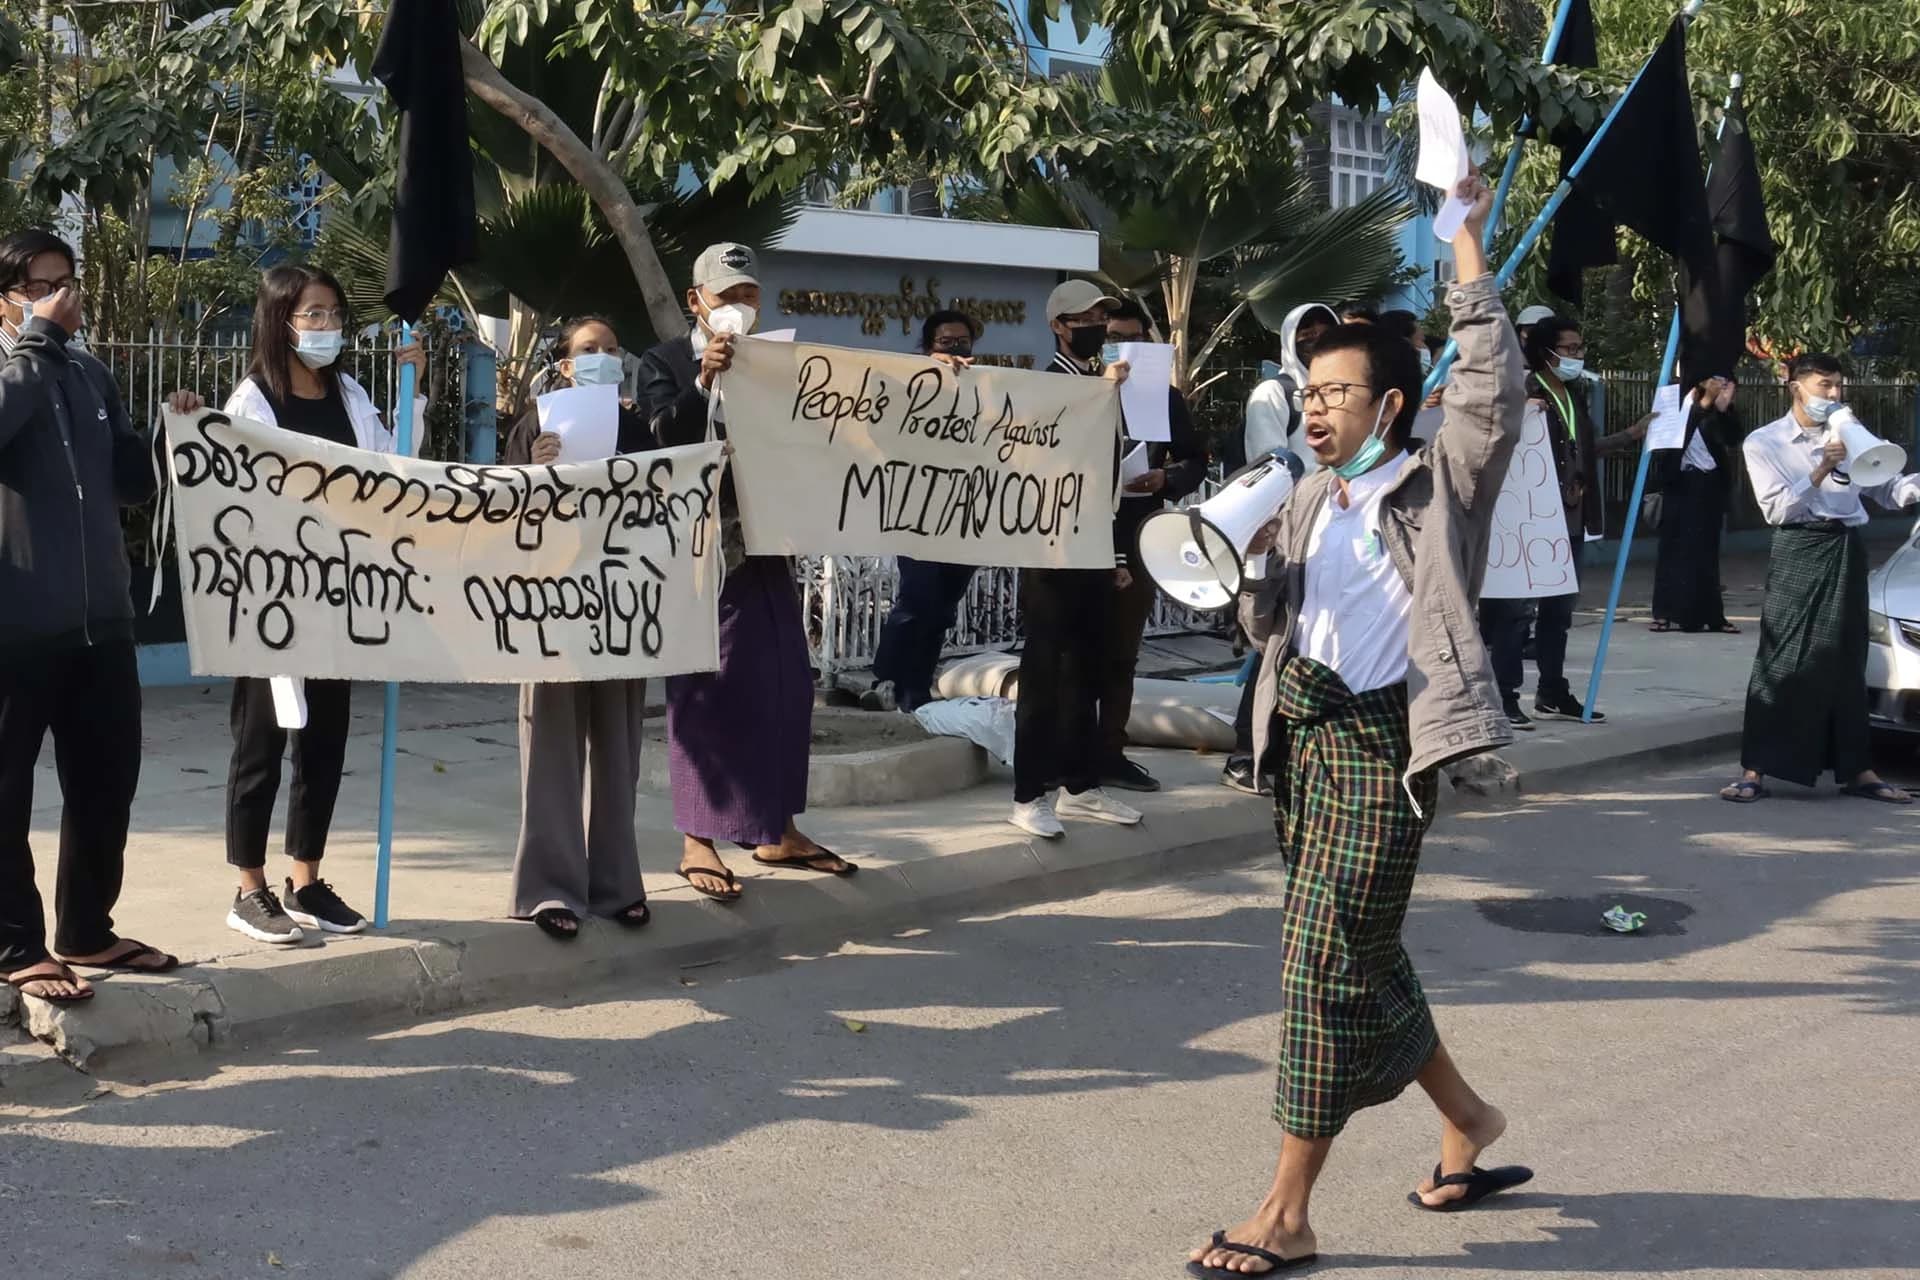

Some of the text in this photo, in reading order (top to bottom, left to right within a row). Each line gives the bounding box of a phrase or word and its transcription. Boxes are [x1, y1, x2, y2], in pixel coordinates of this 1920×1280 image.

[791, 355, 1067, 463] People's Protest Against
[838, 460, 1084, 539] MILITARY COUP!
